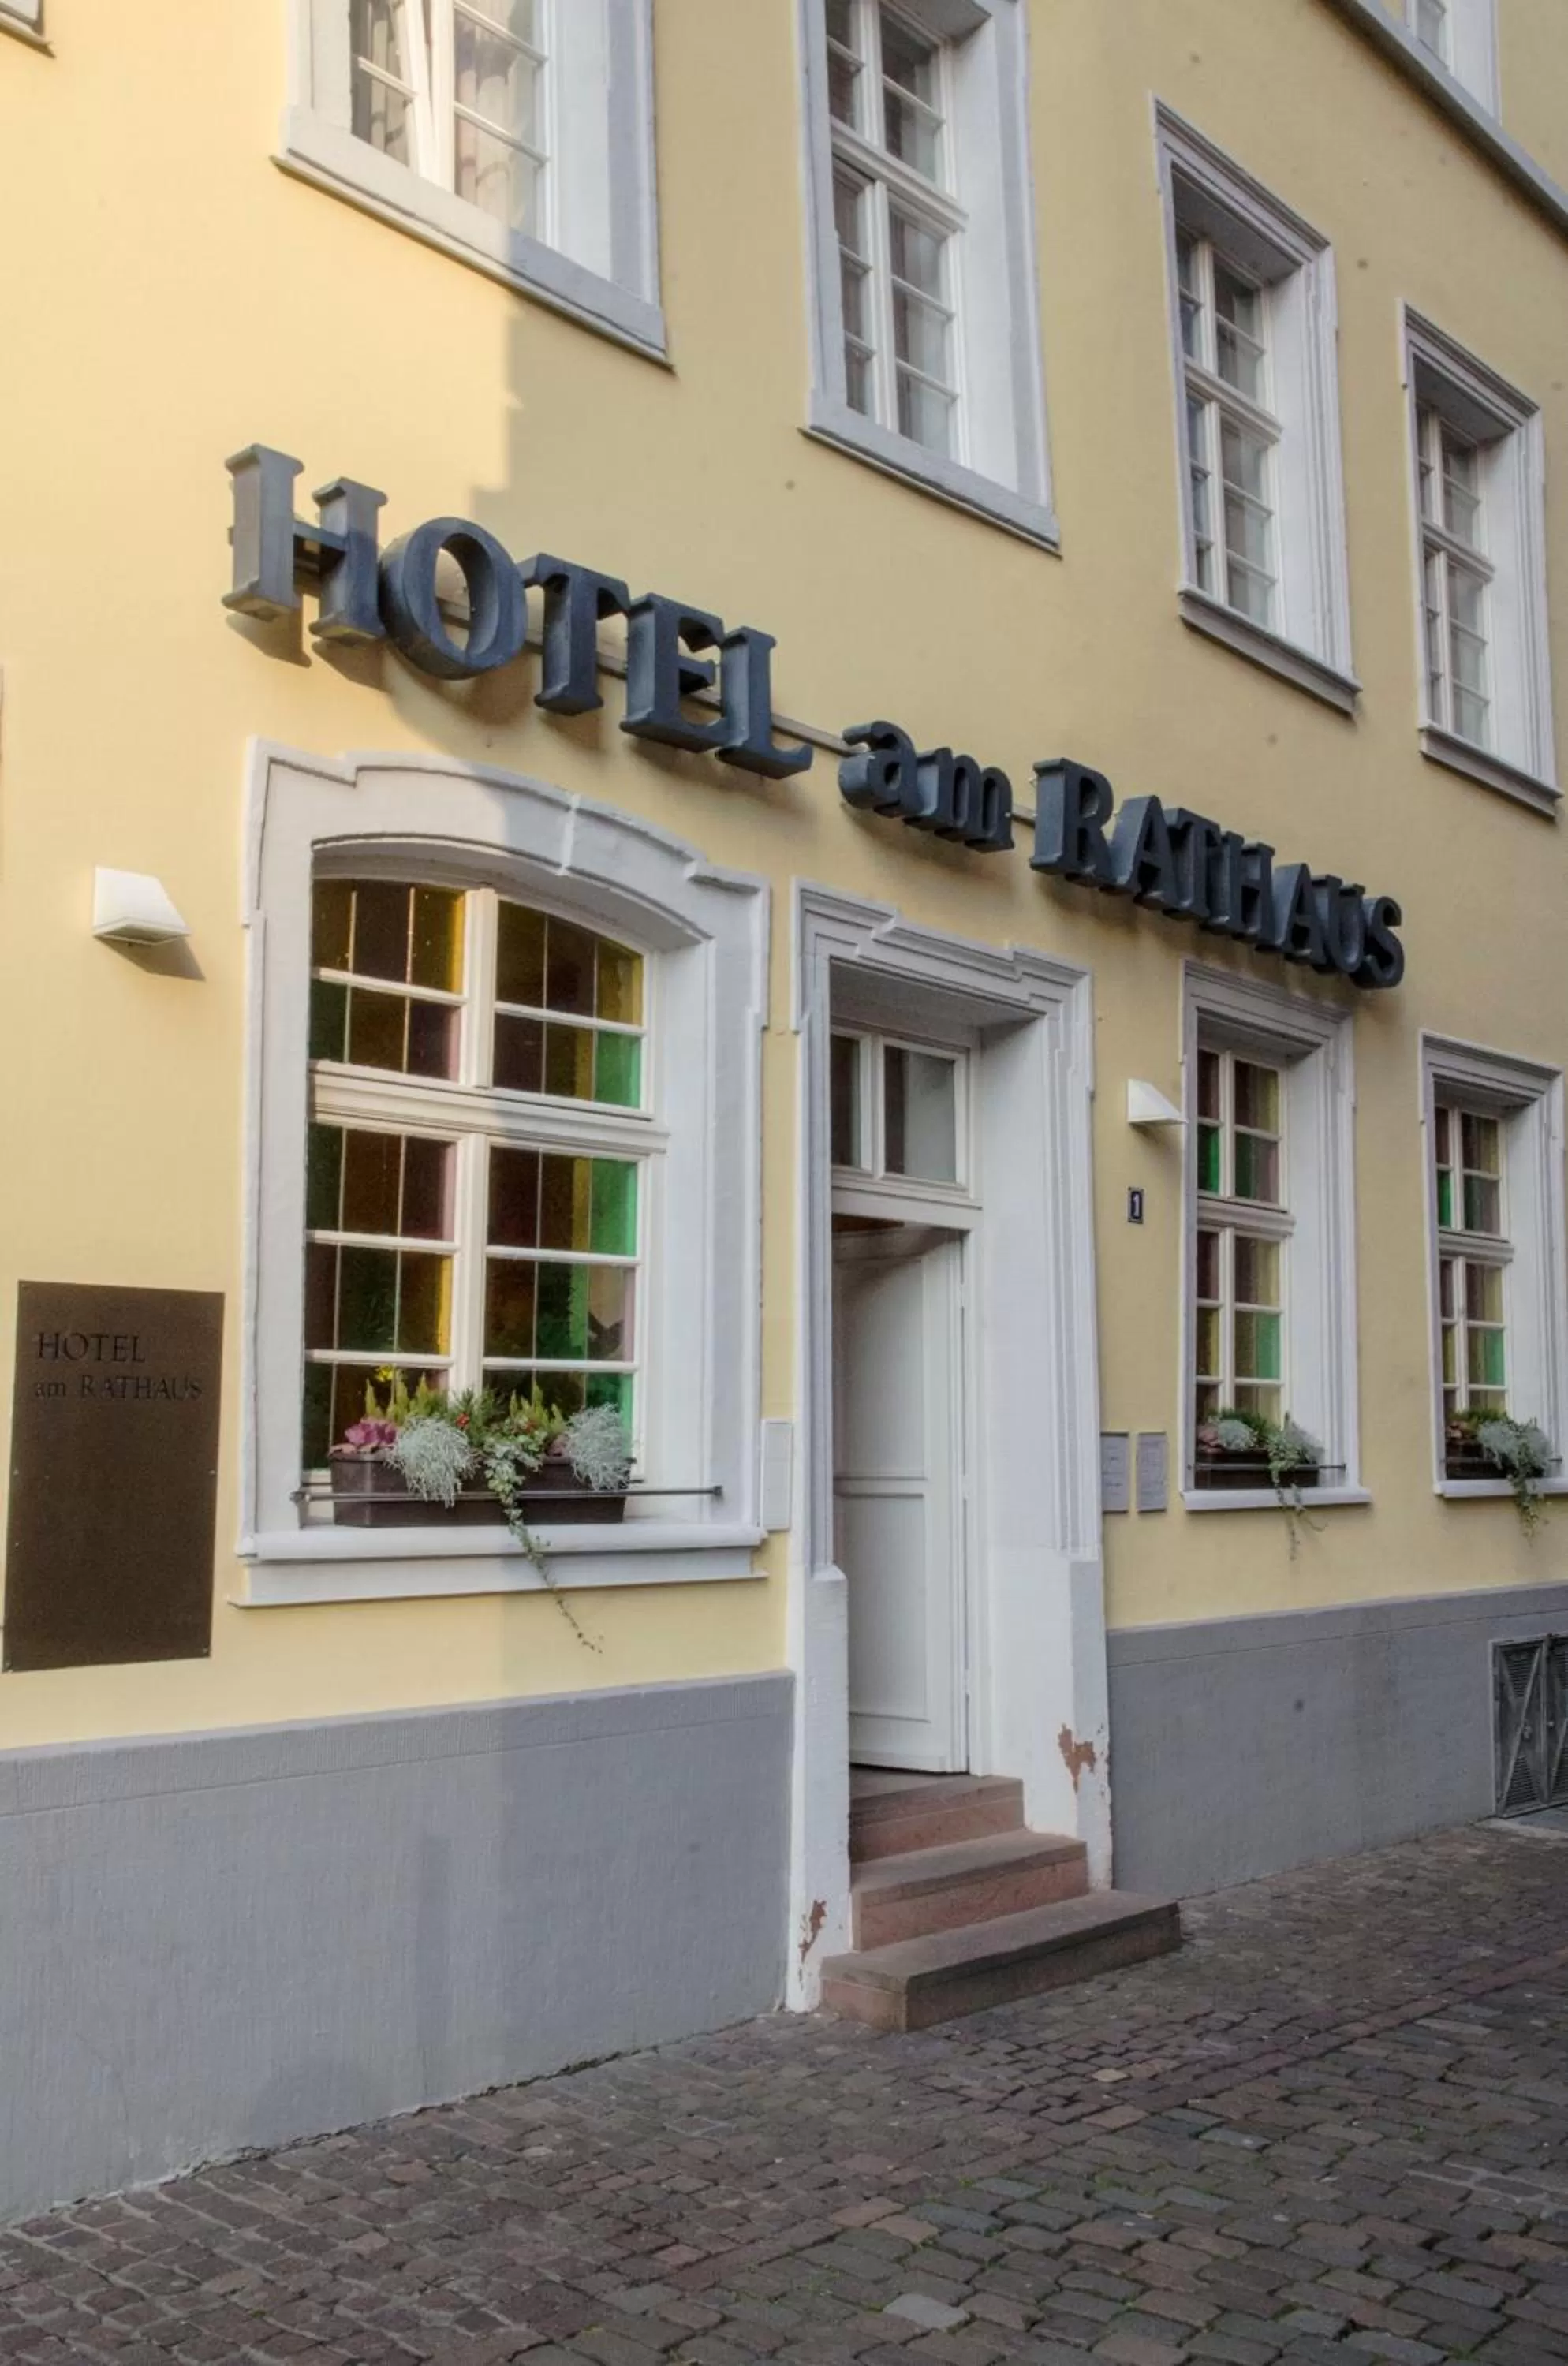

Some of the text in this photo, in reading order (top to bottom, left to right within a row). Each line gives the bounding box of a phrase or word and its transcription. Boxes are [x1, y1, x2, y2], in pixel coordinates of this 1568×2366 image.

[222, 443, 1405, 990] HOTEL am RATHAUS
[1133, 1193, 1140, 1217] 1
[37, 1332, 146, 1363] HOTEL
[34, 1375, 203, 1400] am RATHAUS
